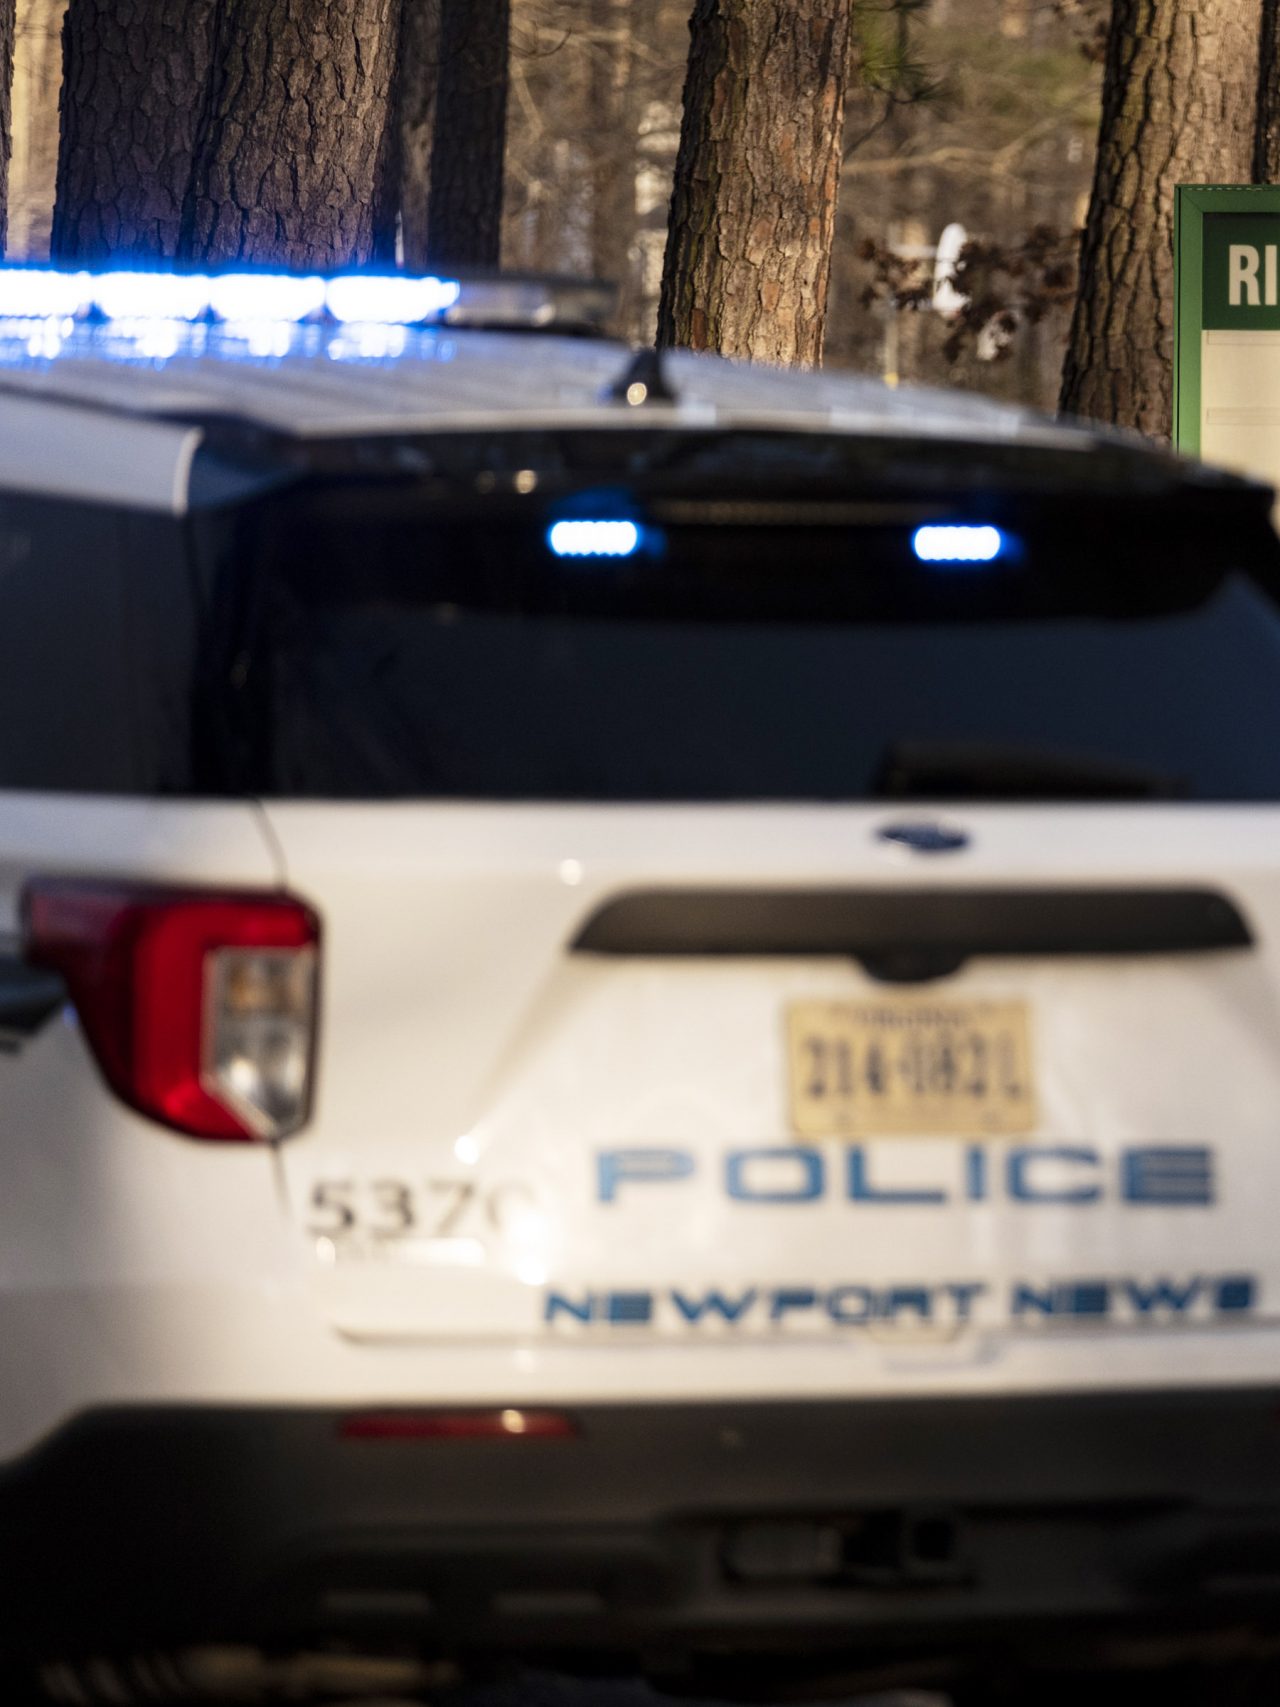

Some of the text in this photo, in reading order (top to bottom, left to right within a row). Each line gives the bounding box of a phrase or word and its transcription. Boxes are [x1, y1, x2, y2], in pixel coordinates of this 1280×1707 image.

[596, 1146, 1213, 1205] POLICE
[545, 1276, 1256, 1325] NEWPORT NEWS
